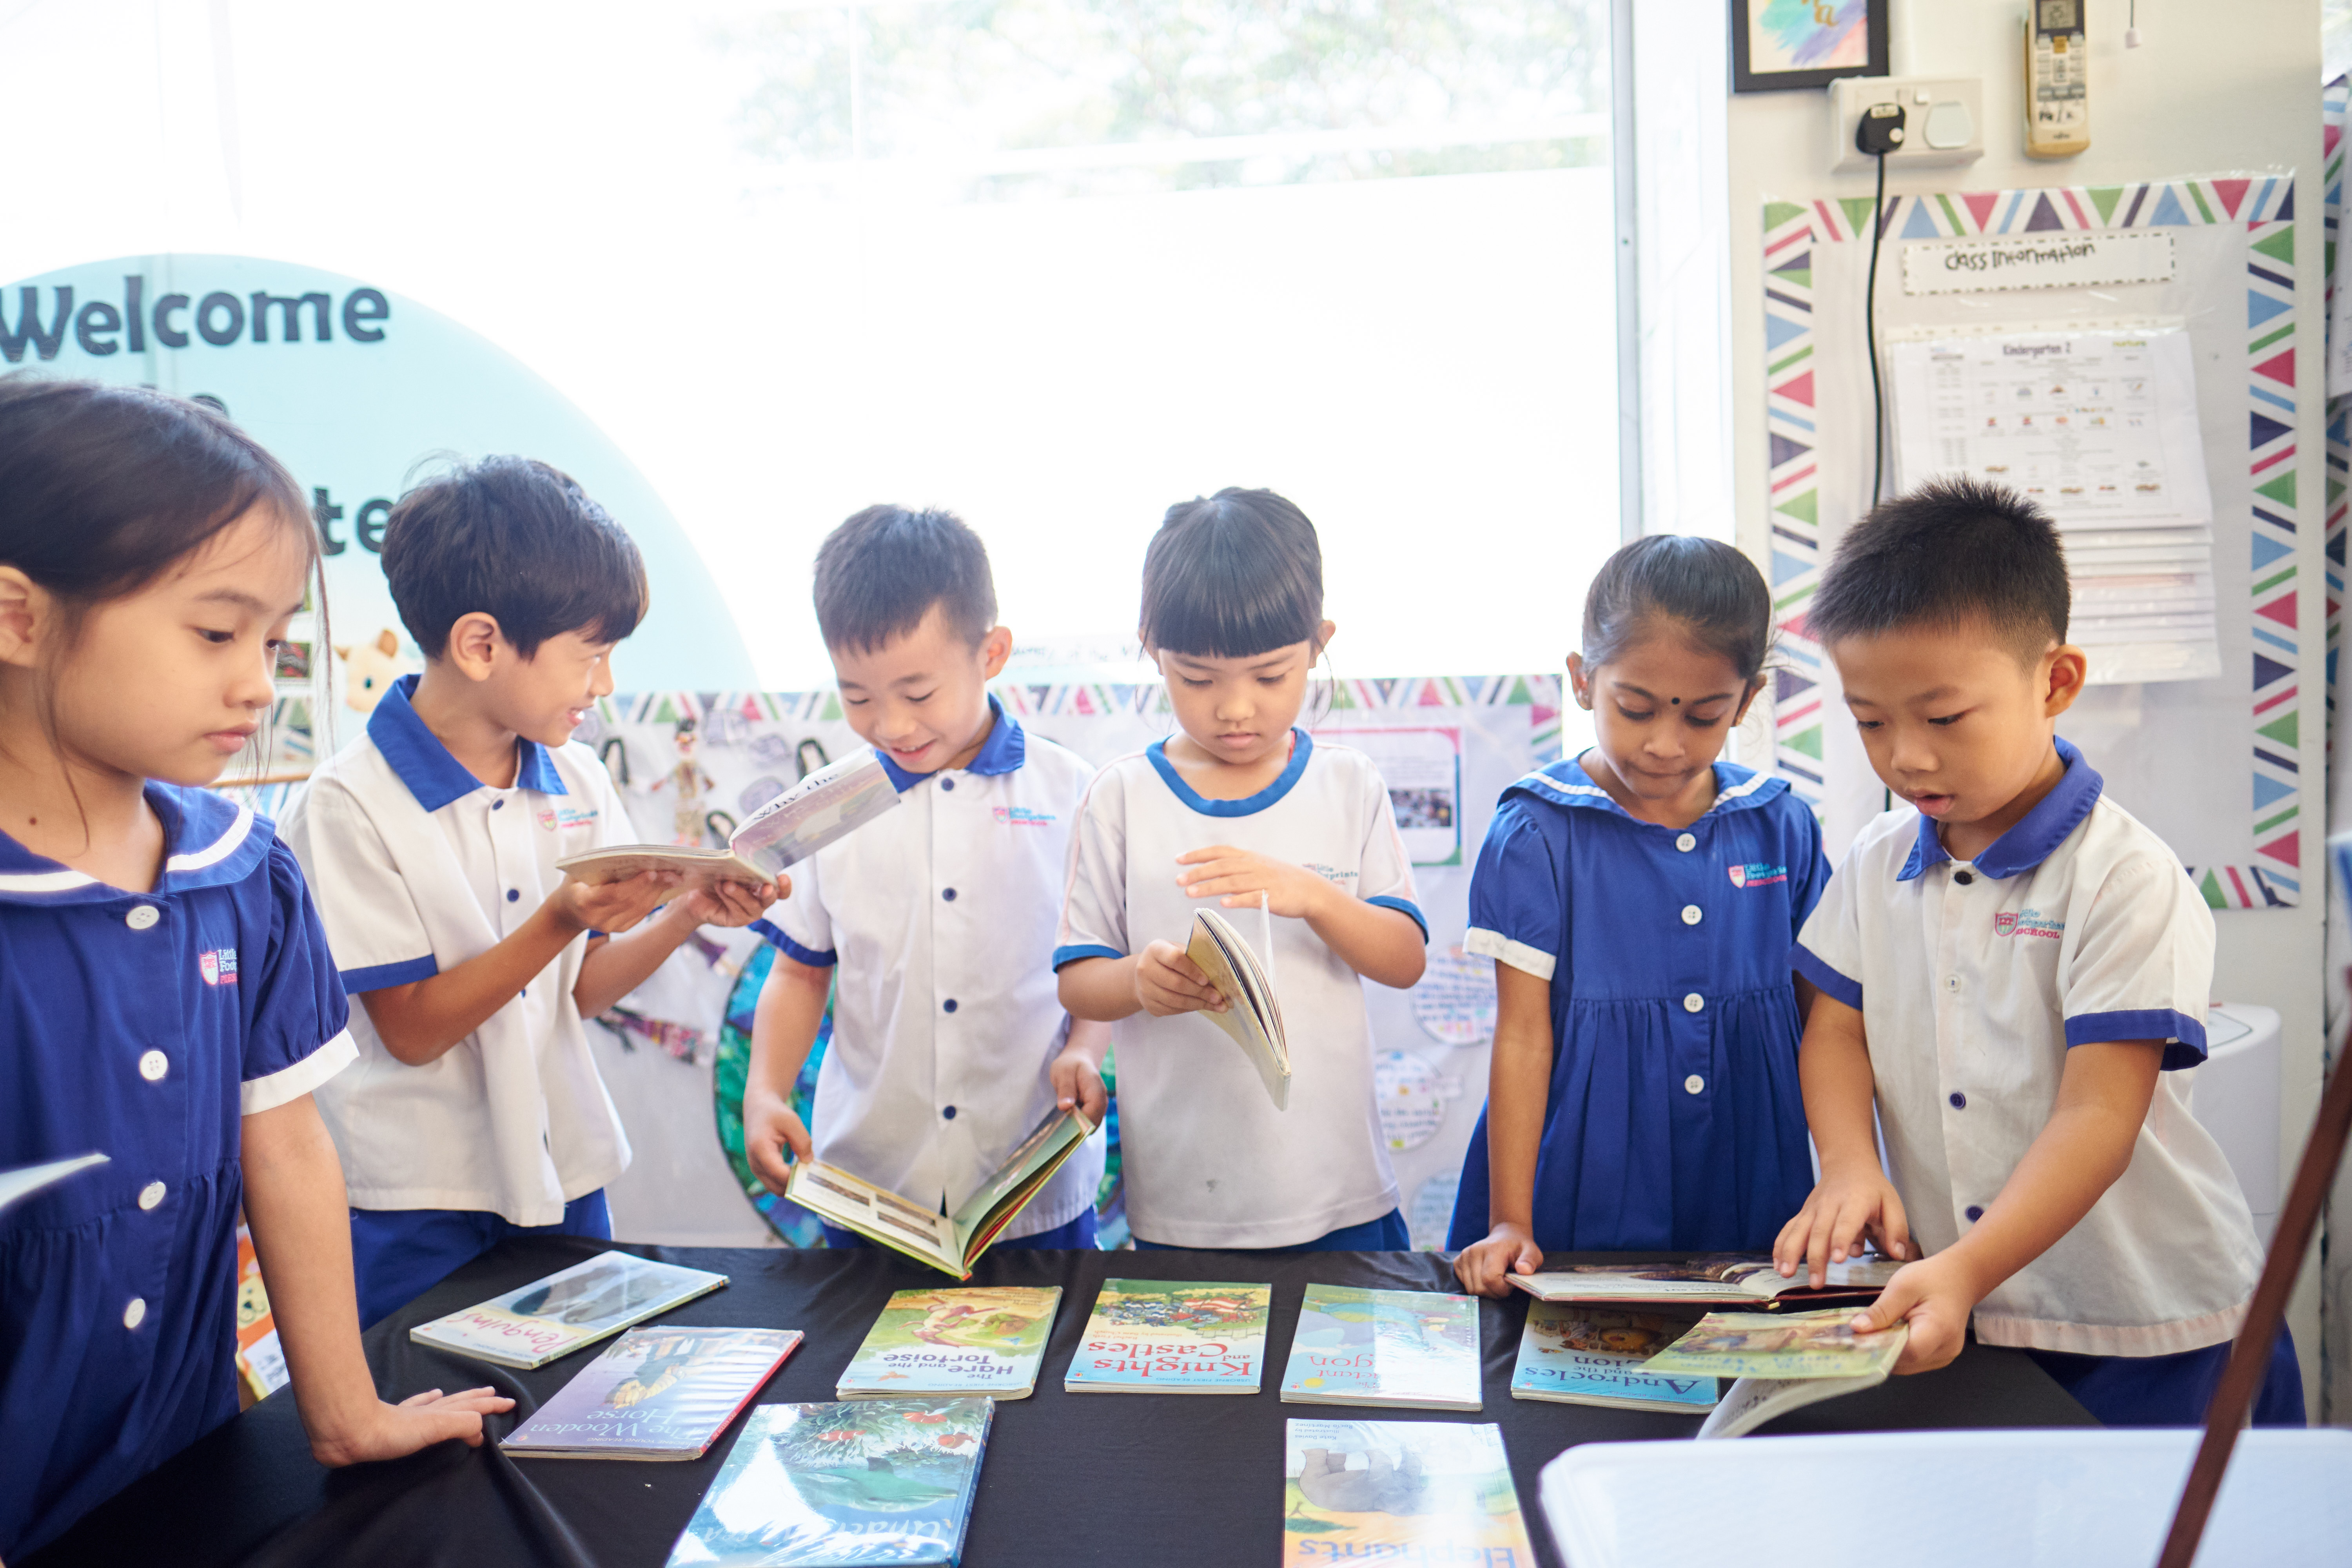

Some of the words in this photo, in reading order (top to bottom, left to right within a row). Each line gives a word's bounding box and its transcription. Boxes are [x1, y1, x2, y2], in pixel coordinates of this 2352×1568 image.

[0, 275, 390, 363] Welcome
[2003, 343, 2062, 358] Kindergarten
[753, 793, 800, 820] Why
[446, 1313, 578, 1354] Penguins
[1087, 1342, 1228, 1359] Castles
[883, 1354, 991, 1365] Tortoise
[1094, 1357, 1254, 1377] Knights
[1307, 1354, 1374, 1367] gon
[947, 1365, 1014, 1375] Hare
[1524, 1367, 1702, 1395] Androcles
[586, 1408, 677, 1425] Horse
[530, 1422, 638, 1437] Wooden
[1298, 1539, 1514, 1568] Elephants
